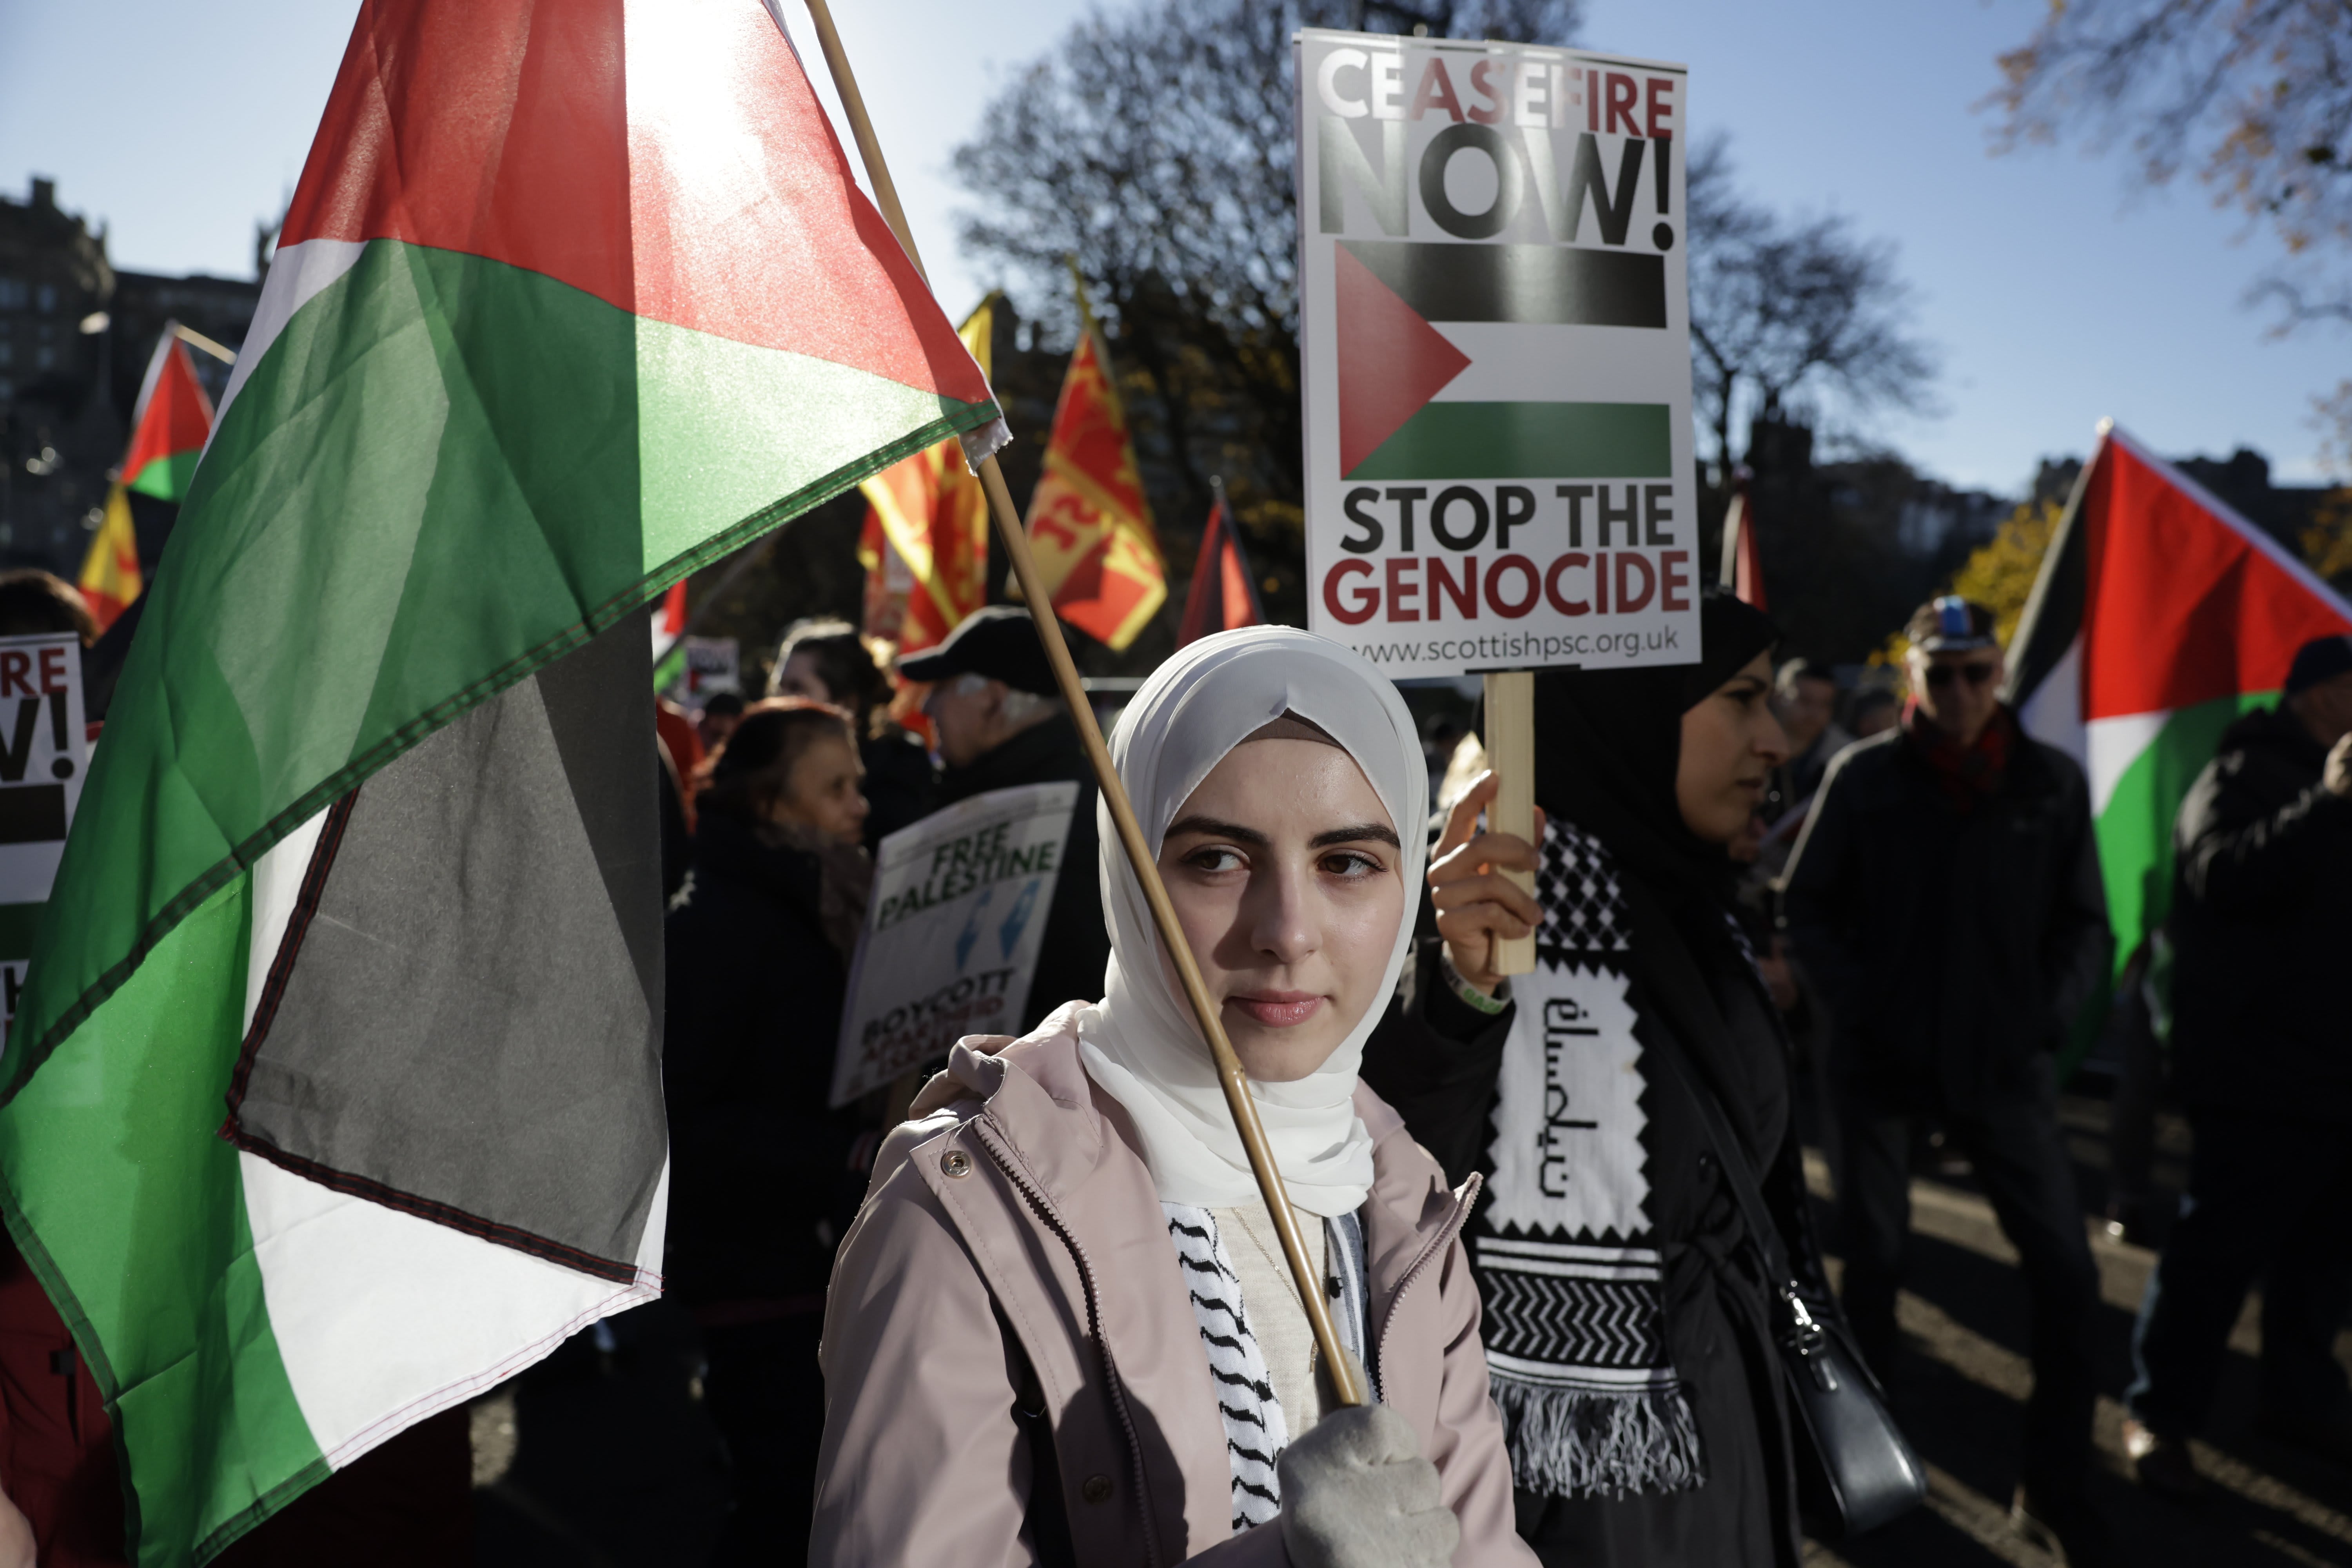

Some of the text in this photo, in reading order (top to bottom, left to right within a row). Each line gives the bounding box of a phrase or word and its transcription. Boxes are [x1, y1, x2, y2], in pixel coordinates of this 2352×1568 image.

[1317, 48, 1674, 140] CEASEFIRE
[1318, 115, 1675, 251] NOW!
[1340, 485, 1675, 554] STOP THE
[1323, 551, 1690, 625] GENOCIDE
[877, 841, 1056, 931] PALESTINE
[932, 822, 1011, 875] FREE
